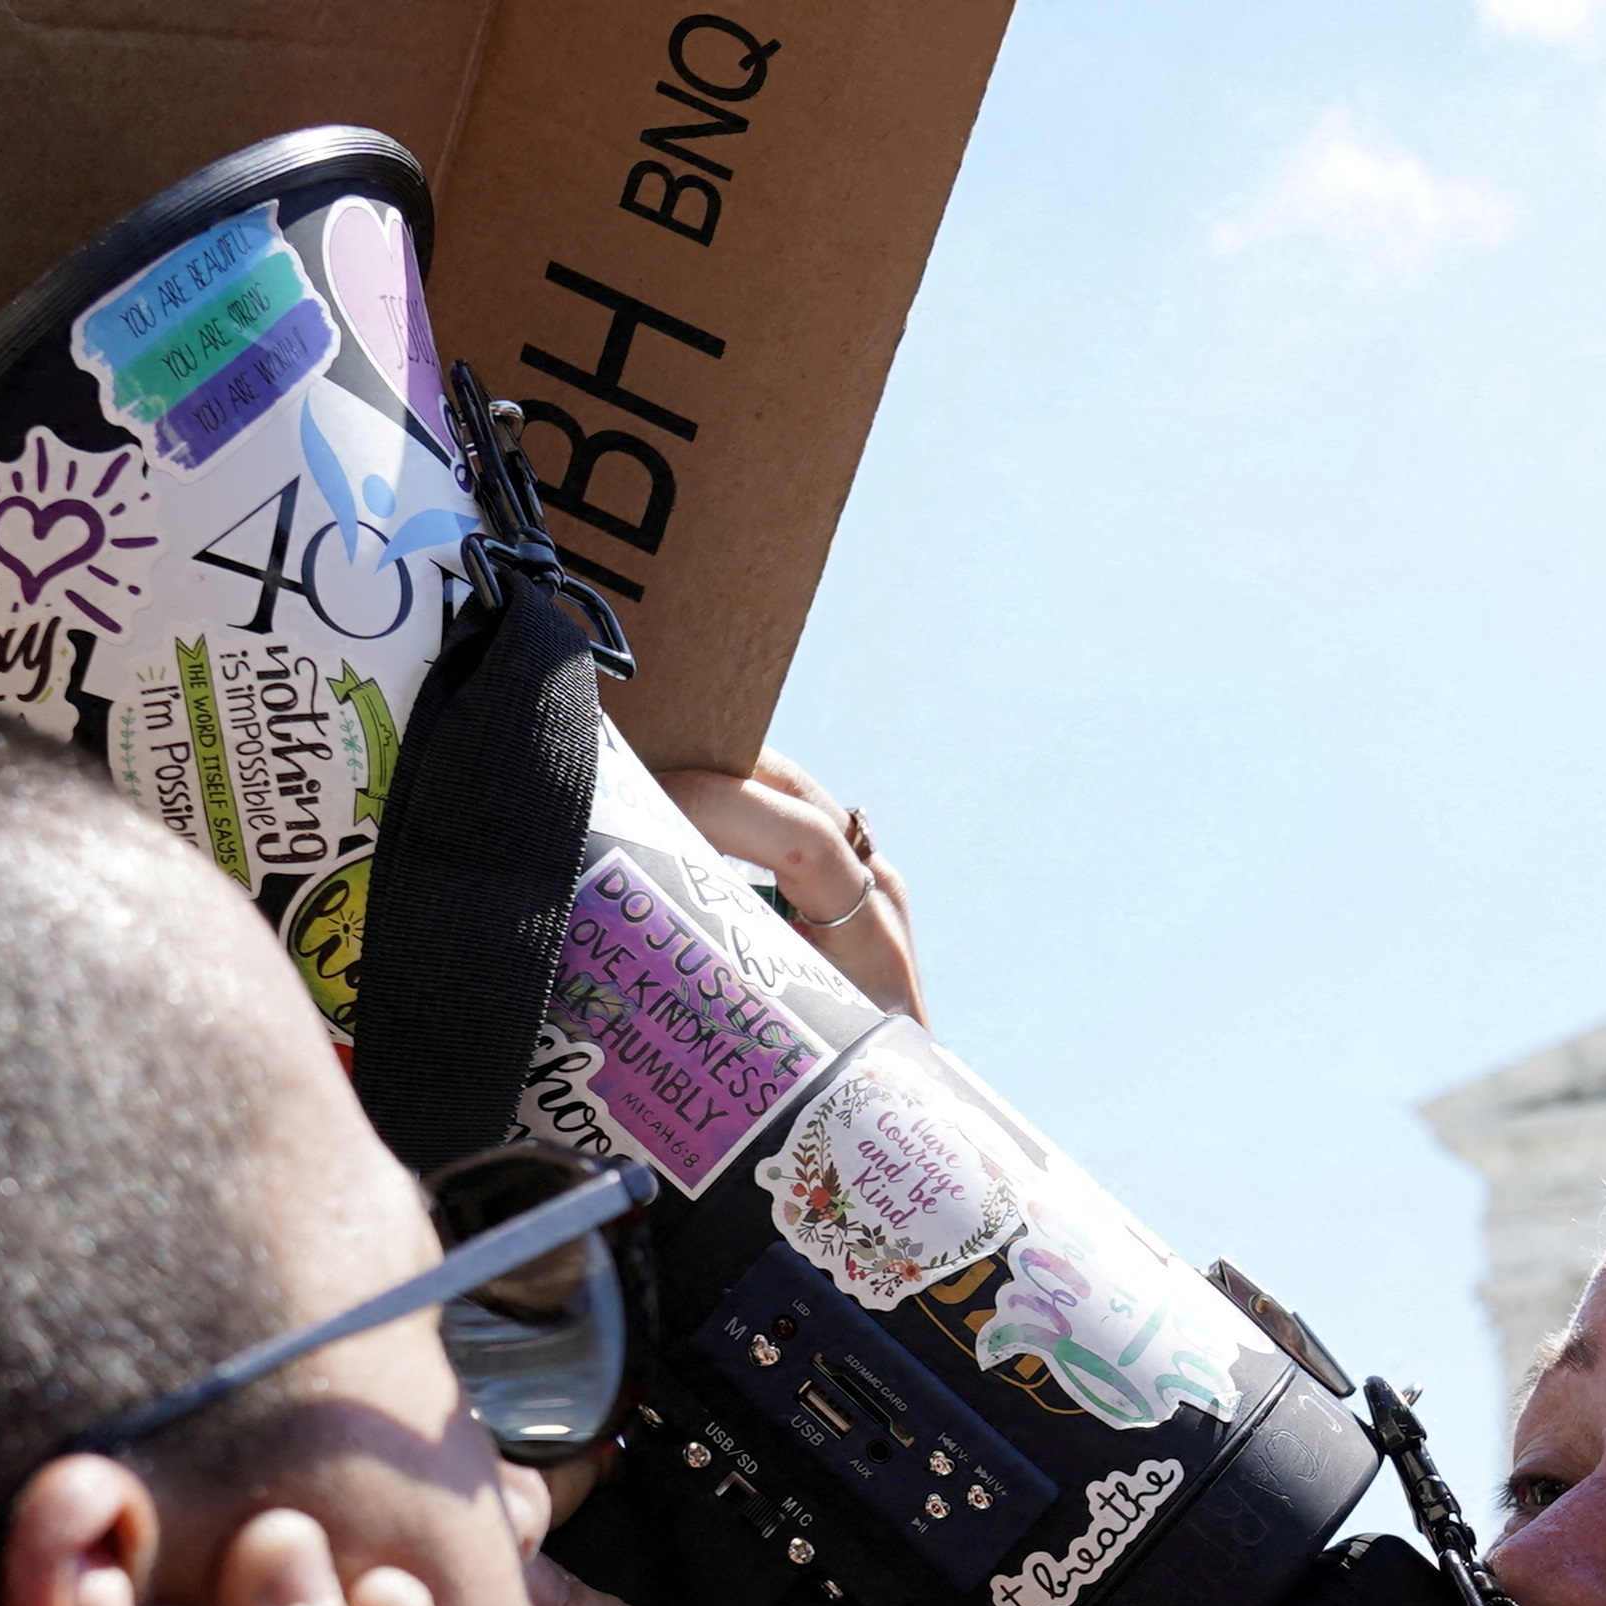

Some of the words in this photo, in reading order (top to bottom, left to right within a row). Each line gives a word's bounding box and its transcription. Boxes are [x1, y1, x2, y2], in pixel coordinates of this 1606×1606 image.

[619, 13, 782, 248] BNQ
[119, 297, 157, 339] YOU
[158, 274, 192, 318] ARE
[187, 223, 254, 292] BEAUTIFUL
[161, 344, 198, 382] YOU
[199, 318, 232, 360] ARE
[227, 282, 270, 334] STRONG
[192, 396, 228, 435] YOU
[227, 373, 262, 413] ARE
[188, 662, 209, 690] THE
[140, 684, 182, 731] I'm
[193, 696, 217, 749] WORD
[203, 754, 231, 809] ITSELF
[256, 645, 334, 864] nothing
[594, 866, 654, 923] DO
[646, 914, 809, 1078] JUSTICE
[568, 919, 638, 981] OVE
[624, 969, 778, 1118] KINDNESS
[597, 1012, 729, 1133] HUMBLY
[622, 1091, 676, 1144] MICAH
[670, 1140, 701, 1169] 6:8
[876, 1110, 967, 1201] Courage
[910, 1117, 962, 1169] Have
[851, 1165, 918, 1231] Kind
[857, 1139, 912, 1183] and
[907, 1176, 939, 1214] be
[724, 1316, 748, 1341] M
[791, 1299, 811, 1317] LED
[844, 1353, 883, 1390] SD/MMC
[879, 1383, 909, 1414] CARD
[704, 1421, 759, 1476] USB/SD
[790, 1414, 825, 1448] USB
[849, 1457, 874, 1480] AUX
[781, 1496, 814, 1528] MIC
[1032, 1469, 1176, 1601] breathe
